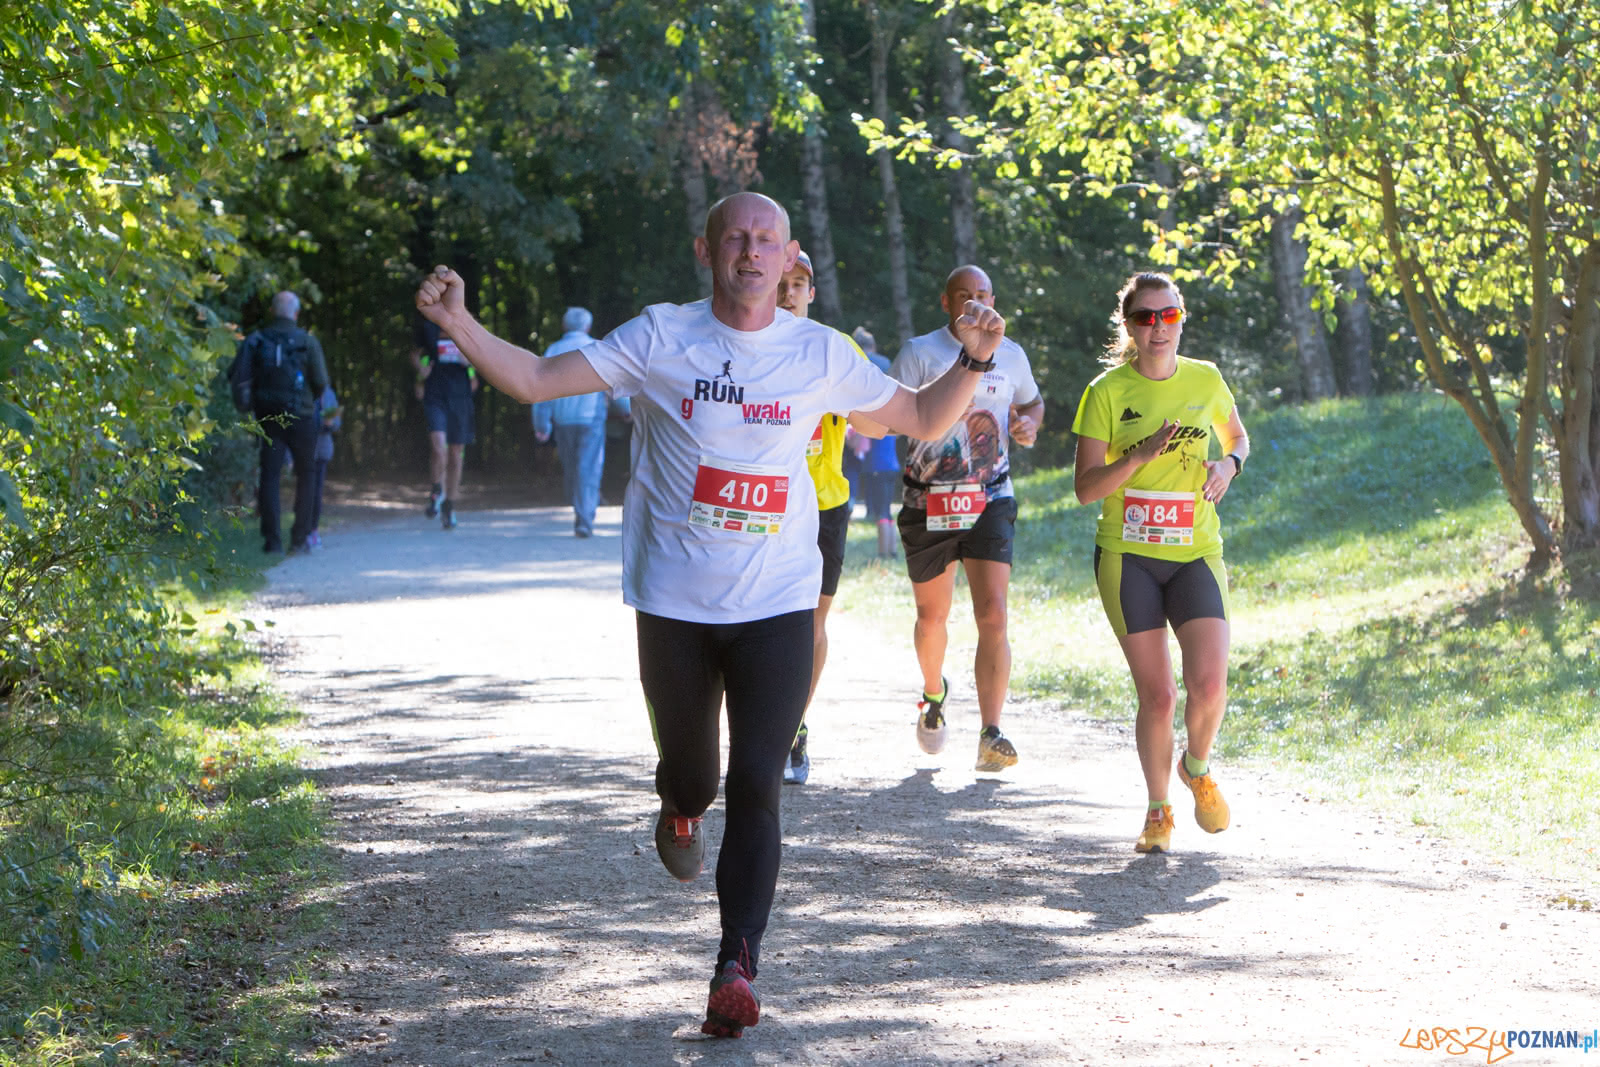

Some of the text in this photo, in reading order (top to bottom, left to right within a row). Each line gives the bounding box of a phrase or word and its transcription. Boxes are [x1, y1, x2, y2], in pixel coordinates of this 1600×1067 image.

[744, 417, 763, 425] TEAM
[719, 480, 768, 507] 410
[942, 497, 972, 512] 100
[1144, 505, 1177, 523] 184
